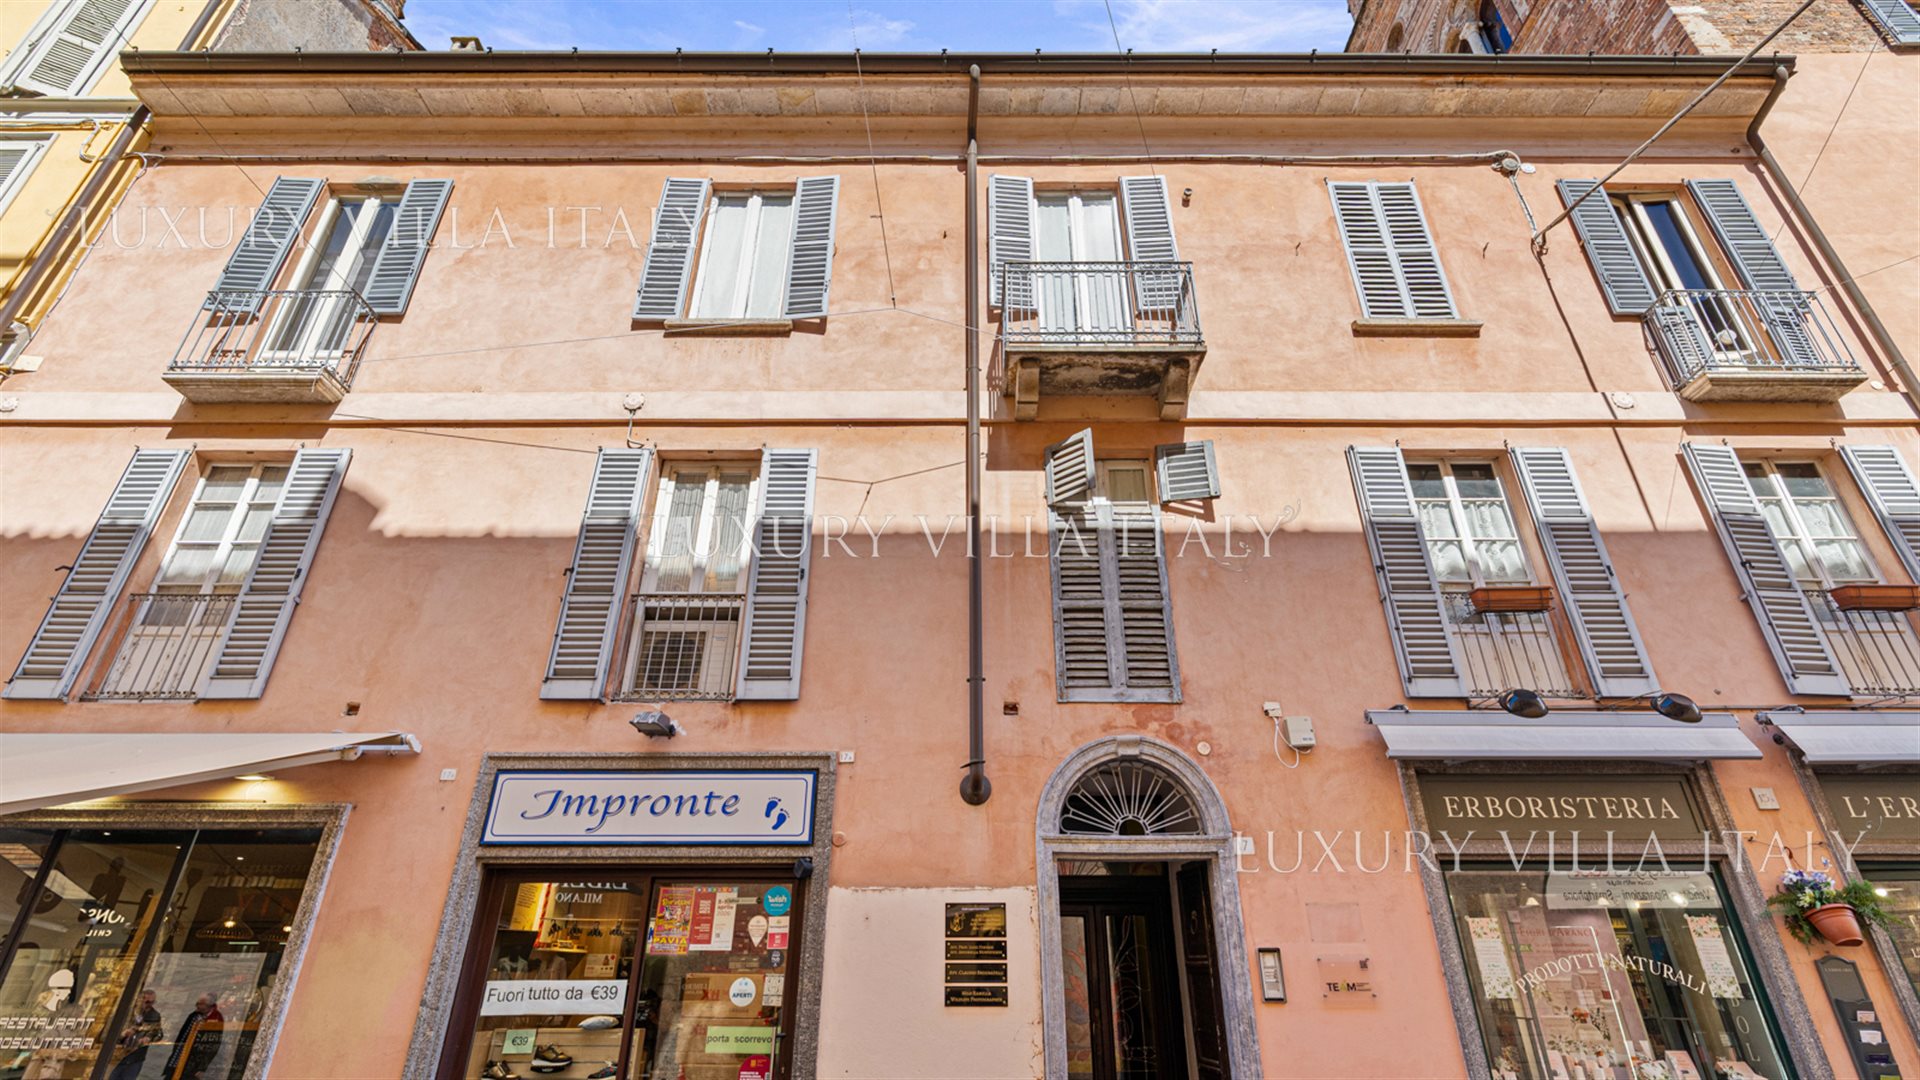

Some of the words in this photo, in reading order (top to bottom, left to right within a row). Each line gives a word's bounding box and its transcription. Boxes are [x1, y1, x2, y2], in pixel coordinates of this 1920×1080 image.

[521, 789, 741, 834] Impronte
[1443, 796, 1680, 819] ERBORISTERIA
[653, 937, 687, 945] PAVIA
[1515, 953, 1604, 994] PRODOTTI
[1608, 952, 1707, 995] NATURALI
[487, 988, 525, 1002] Fuori
[529, 986, 560, 1000] tutto
[565, 987, 583, 1000] da
[591, 985, 618, 1000] €39
[511, 1036, 529, 1046] €39
[707, 1035, 729, 1043] porta
